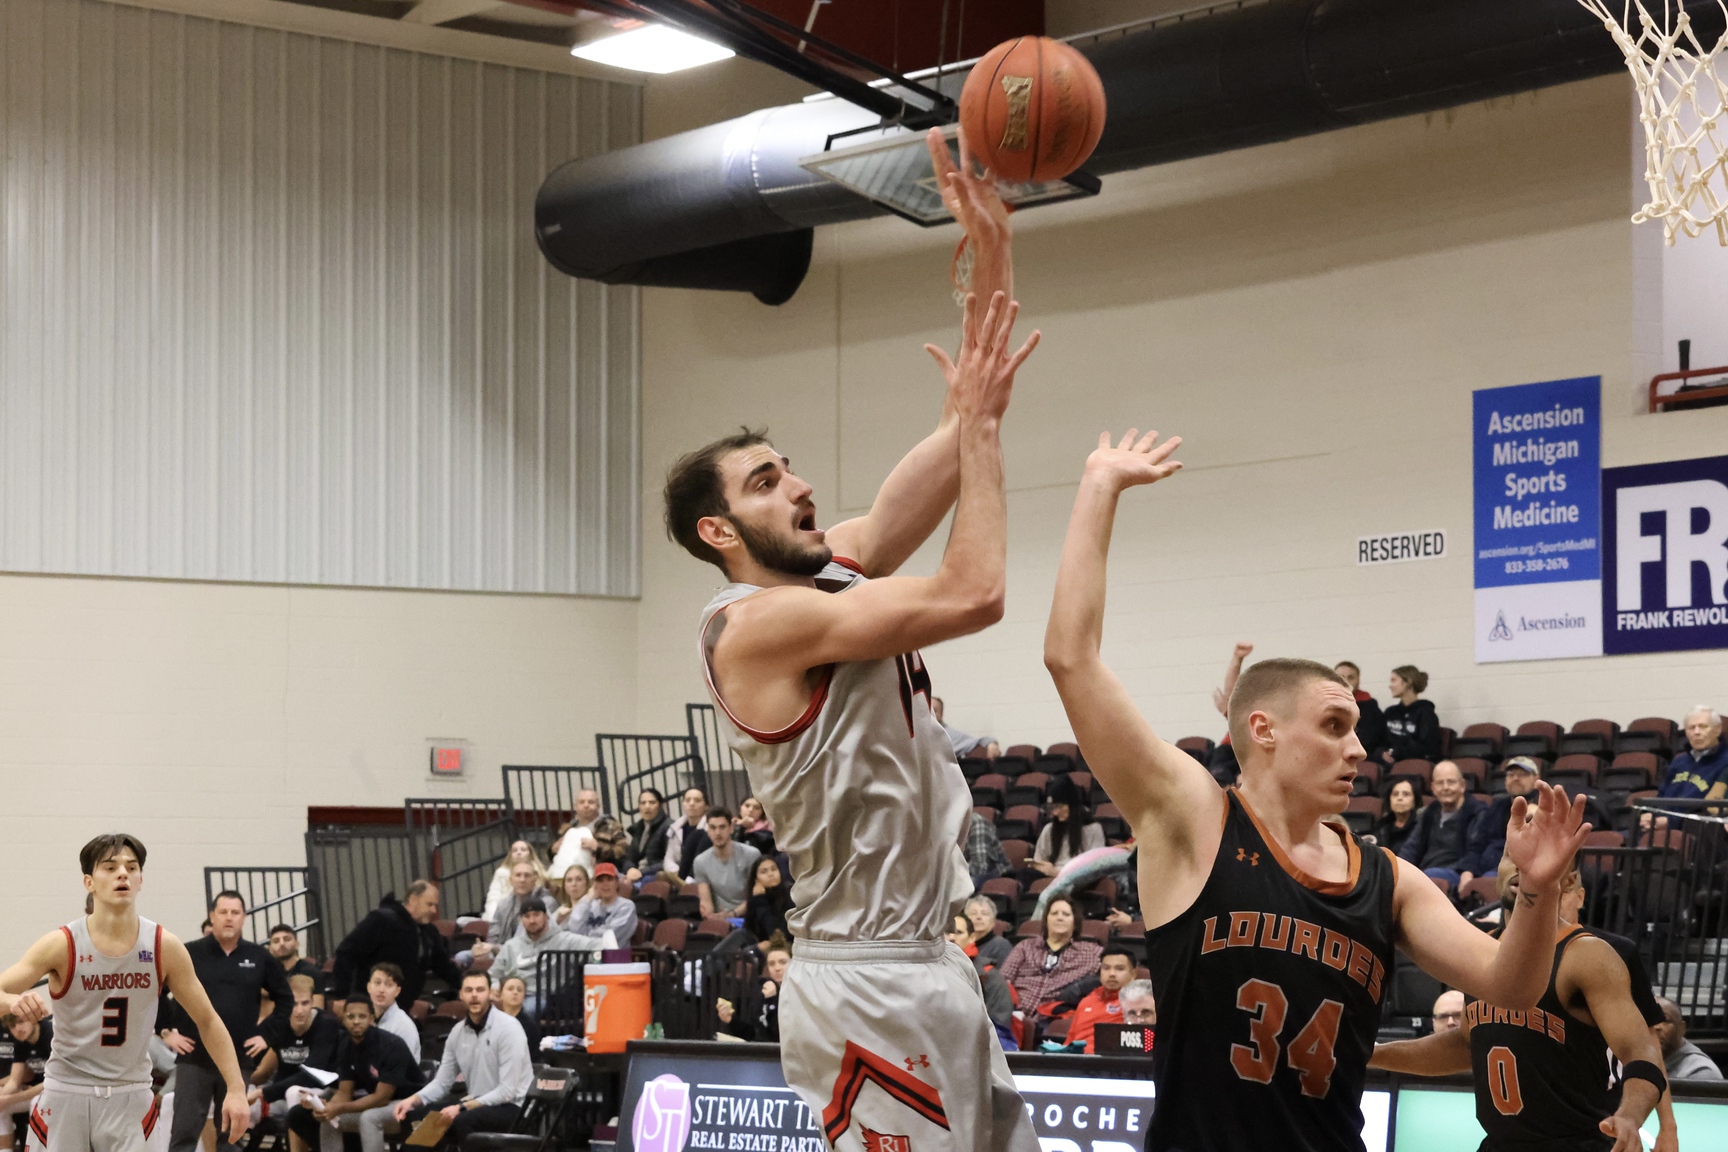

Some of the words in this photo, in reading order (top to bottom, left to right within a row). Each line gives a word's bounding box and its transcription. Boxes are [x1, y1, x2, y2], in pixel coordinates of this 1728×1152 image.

[1488, 403, 1585, 435] Ascension
[1493, 437, 1579, 466] Michigan
[1505, 470, 1567, 501] Sports
[1494, 500, 1580, 530] Medicine
[1359, 532, 1444, 563] RESERVED
[1504, 557, 1570, 574] 833-358-2676
[1518, 613, 1586, 631] Ascension
[1617, 611, 1671, 631] FRANK
[1201, 911, 1385, 1005] LOURDES
[81, 972, 151, 991] WARRIORS
[101, 997, 128, 1047] 3
[1467, 999, 1565, 1045] OURDES
[1120, 1031, 1143, 1048] POSS.
[1230, 977, 1344, 1099] 34
[1487, 1045, 1524, 1115] 0
[692, 1095, 789, 1129] STEWART
[691, 1130, 726, 1148] REAL
[729, 1133, 777, 1151] ESTATE
